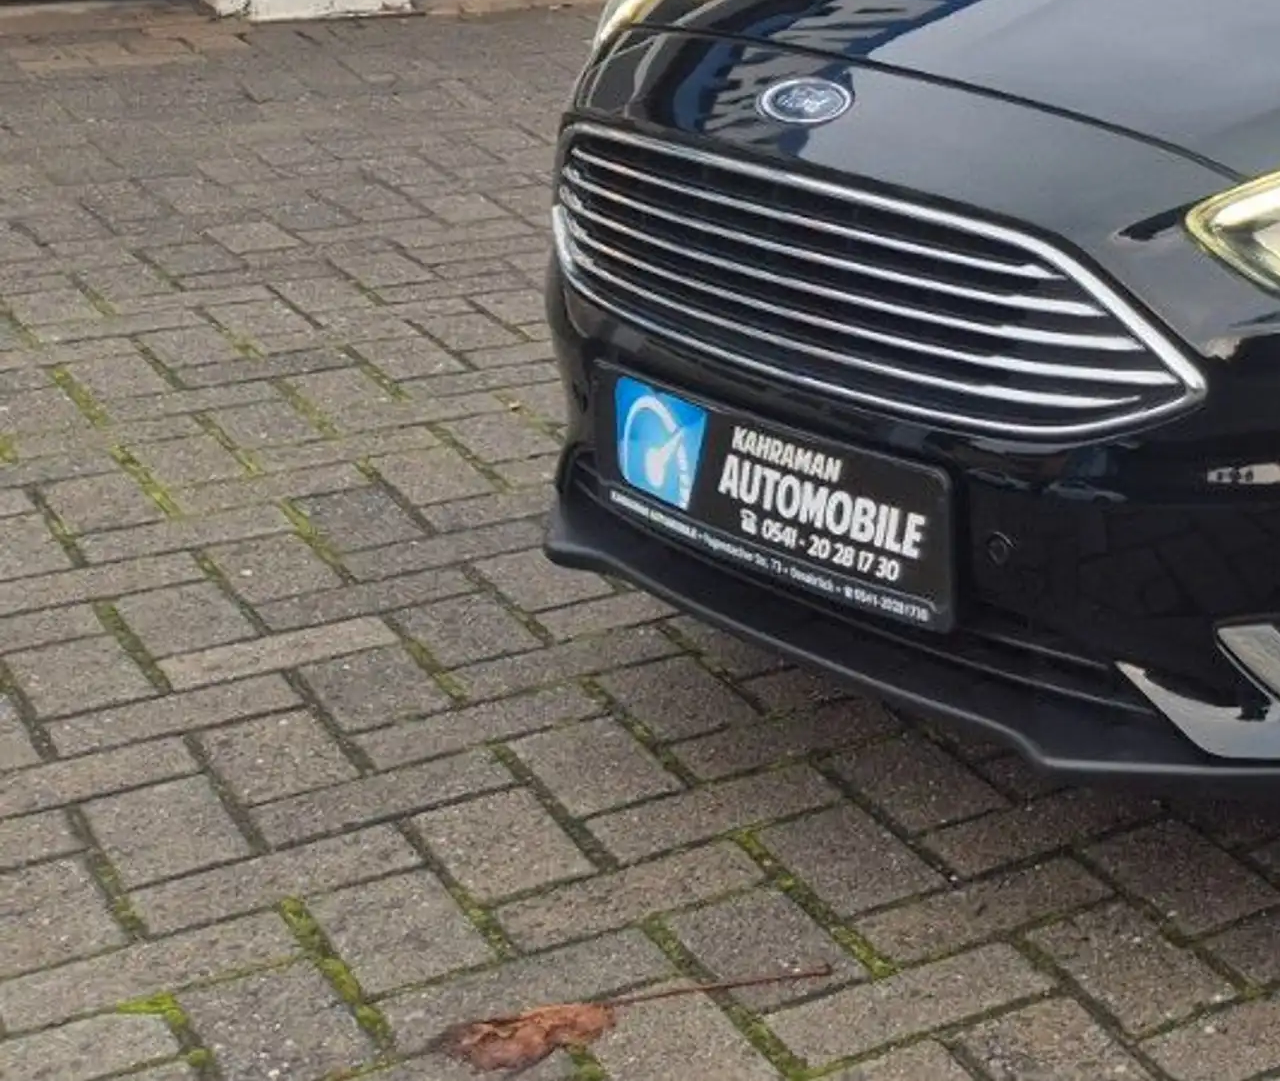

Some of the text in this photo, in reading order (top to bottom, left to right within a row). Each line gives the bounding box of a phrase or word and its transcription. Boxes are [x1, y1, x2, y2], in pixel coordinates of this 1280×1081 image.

[731, 425, 843, 483] KAHRAMAN
[717, 454, 926, 559] AUTOMOBILE
[761, 518, 798, 549] 0541
[807, 534, 831, 559] 20
[832, 543, 856, 567] 28
[856, 550, 875, 573] 17
[875, 556, 900, 581] 30
